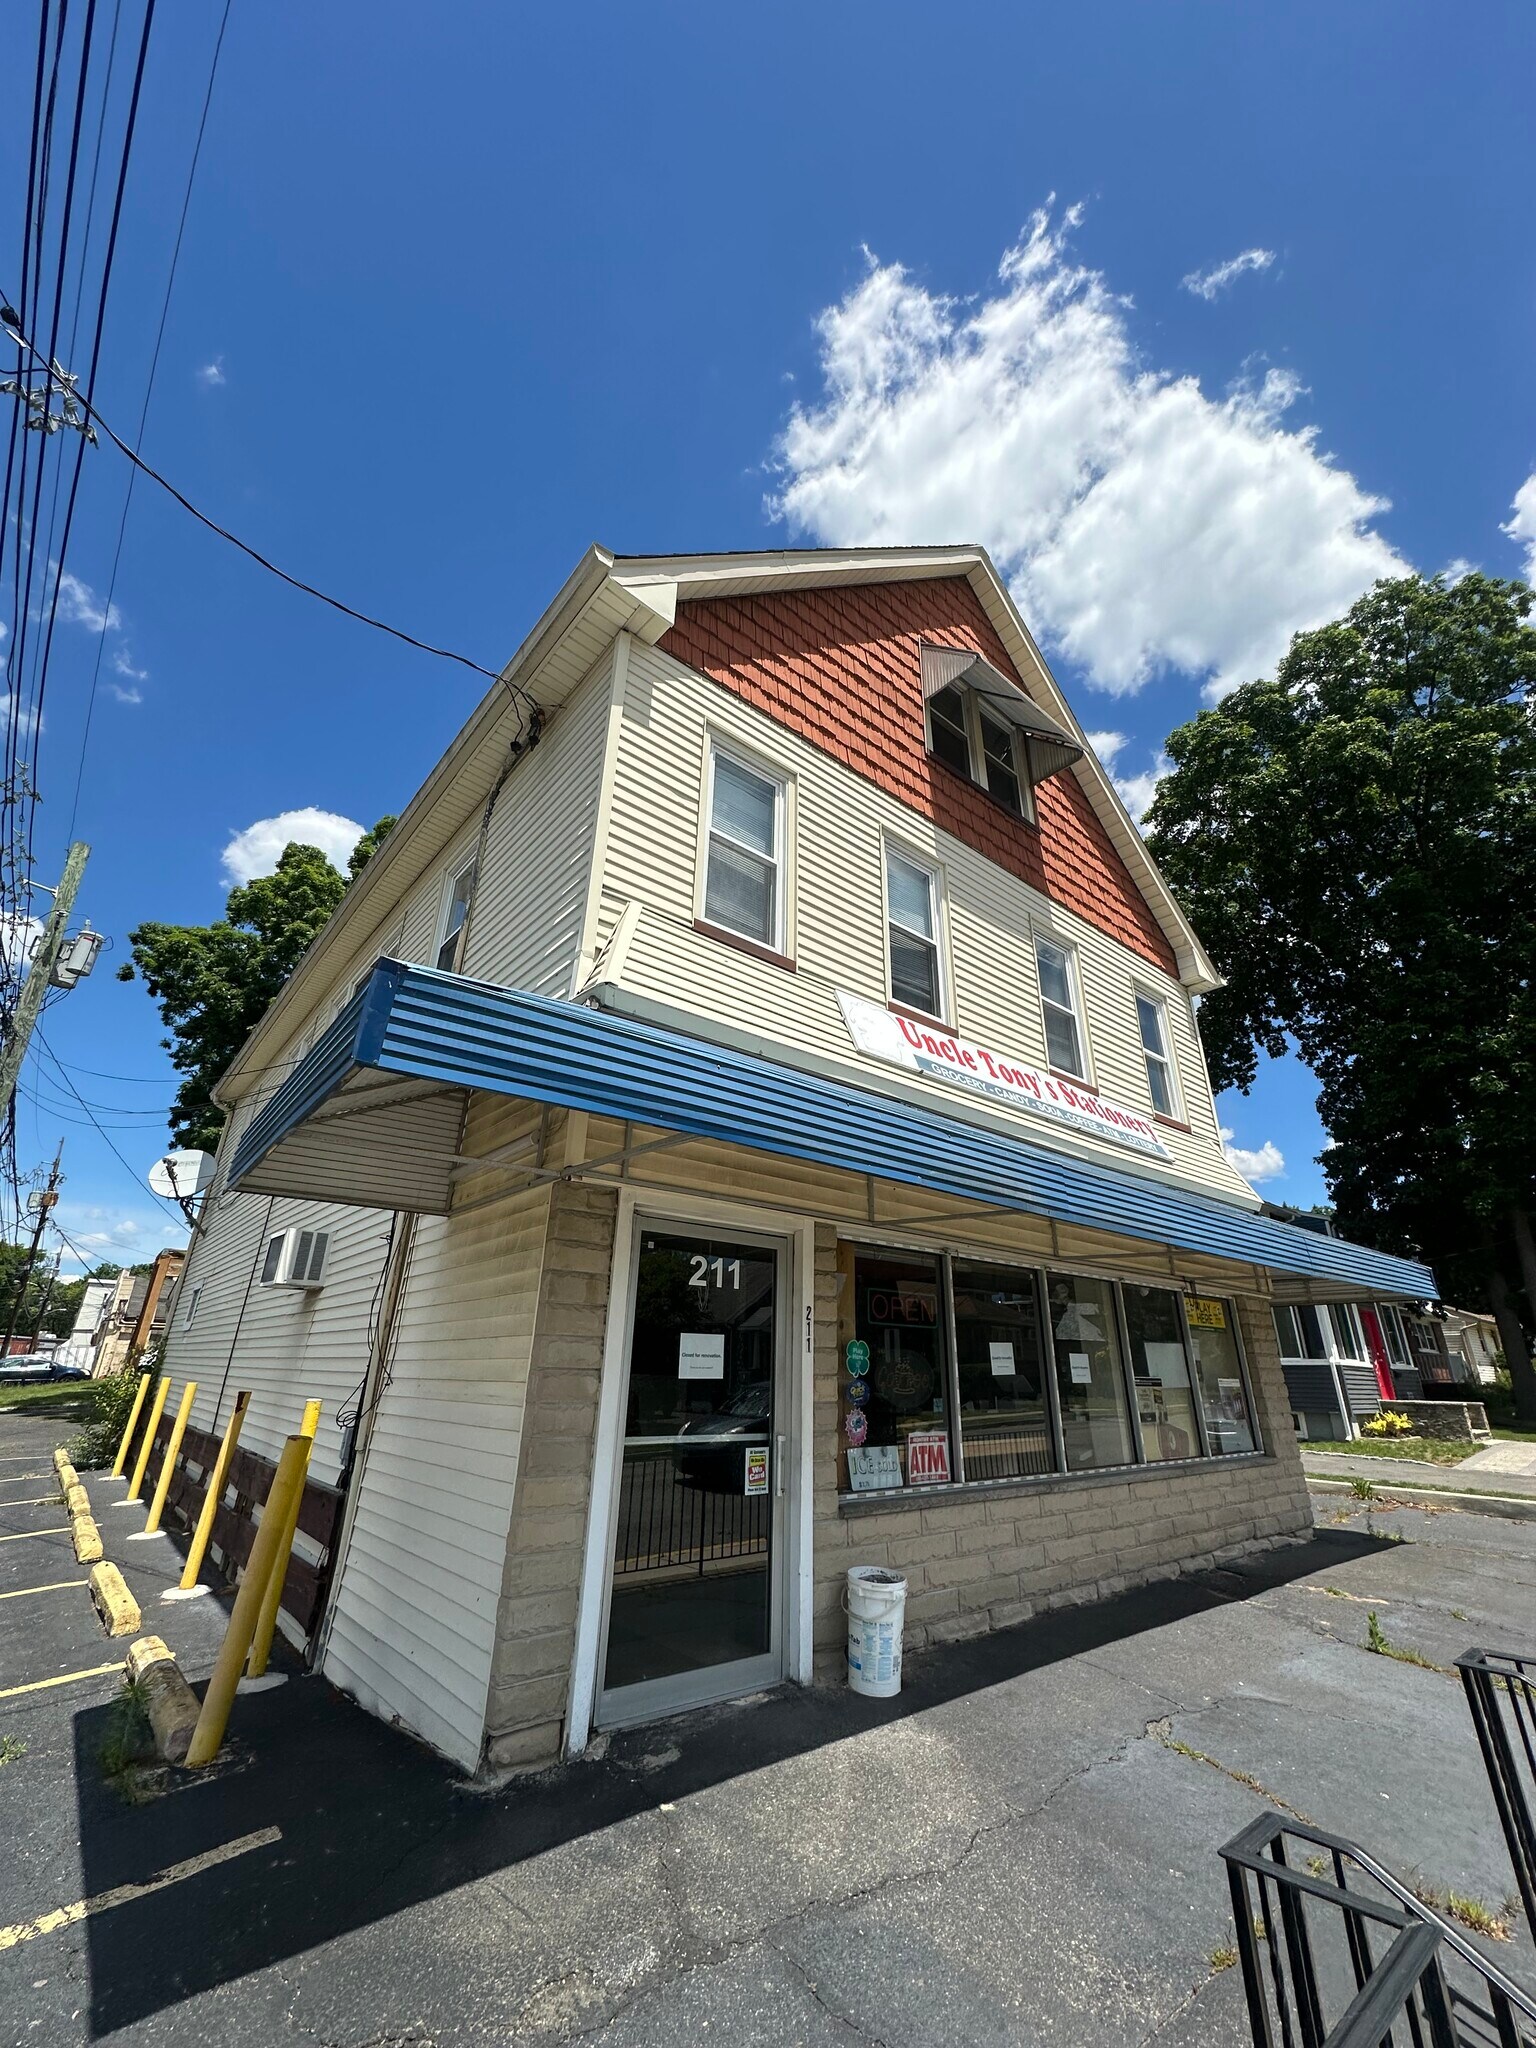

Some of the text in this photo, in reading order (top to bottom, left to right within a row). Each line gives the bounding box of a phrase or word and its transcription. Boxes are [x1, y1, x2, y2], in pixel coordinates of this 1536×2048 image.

[896, 1017, 1159, 1143] Uncle Tony's Stationery
[932, 1063, 1159, 1152] GROCERY CANDY SODA COFFEE ATM LOTTERY
[688, 1255, 740, 1290] 211
[872, 1294, 934, 1322] OPEN
[850, 1456, 874, 1475] ICE
[911, 1445, 947, 1474] ATM
[750, 1471, 765, 1480] Card
